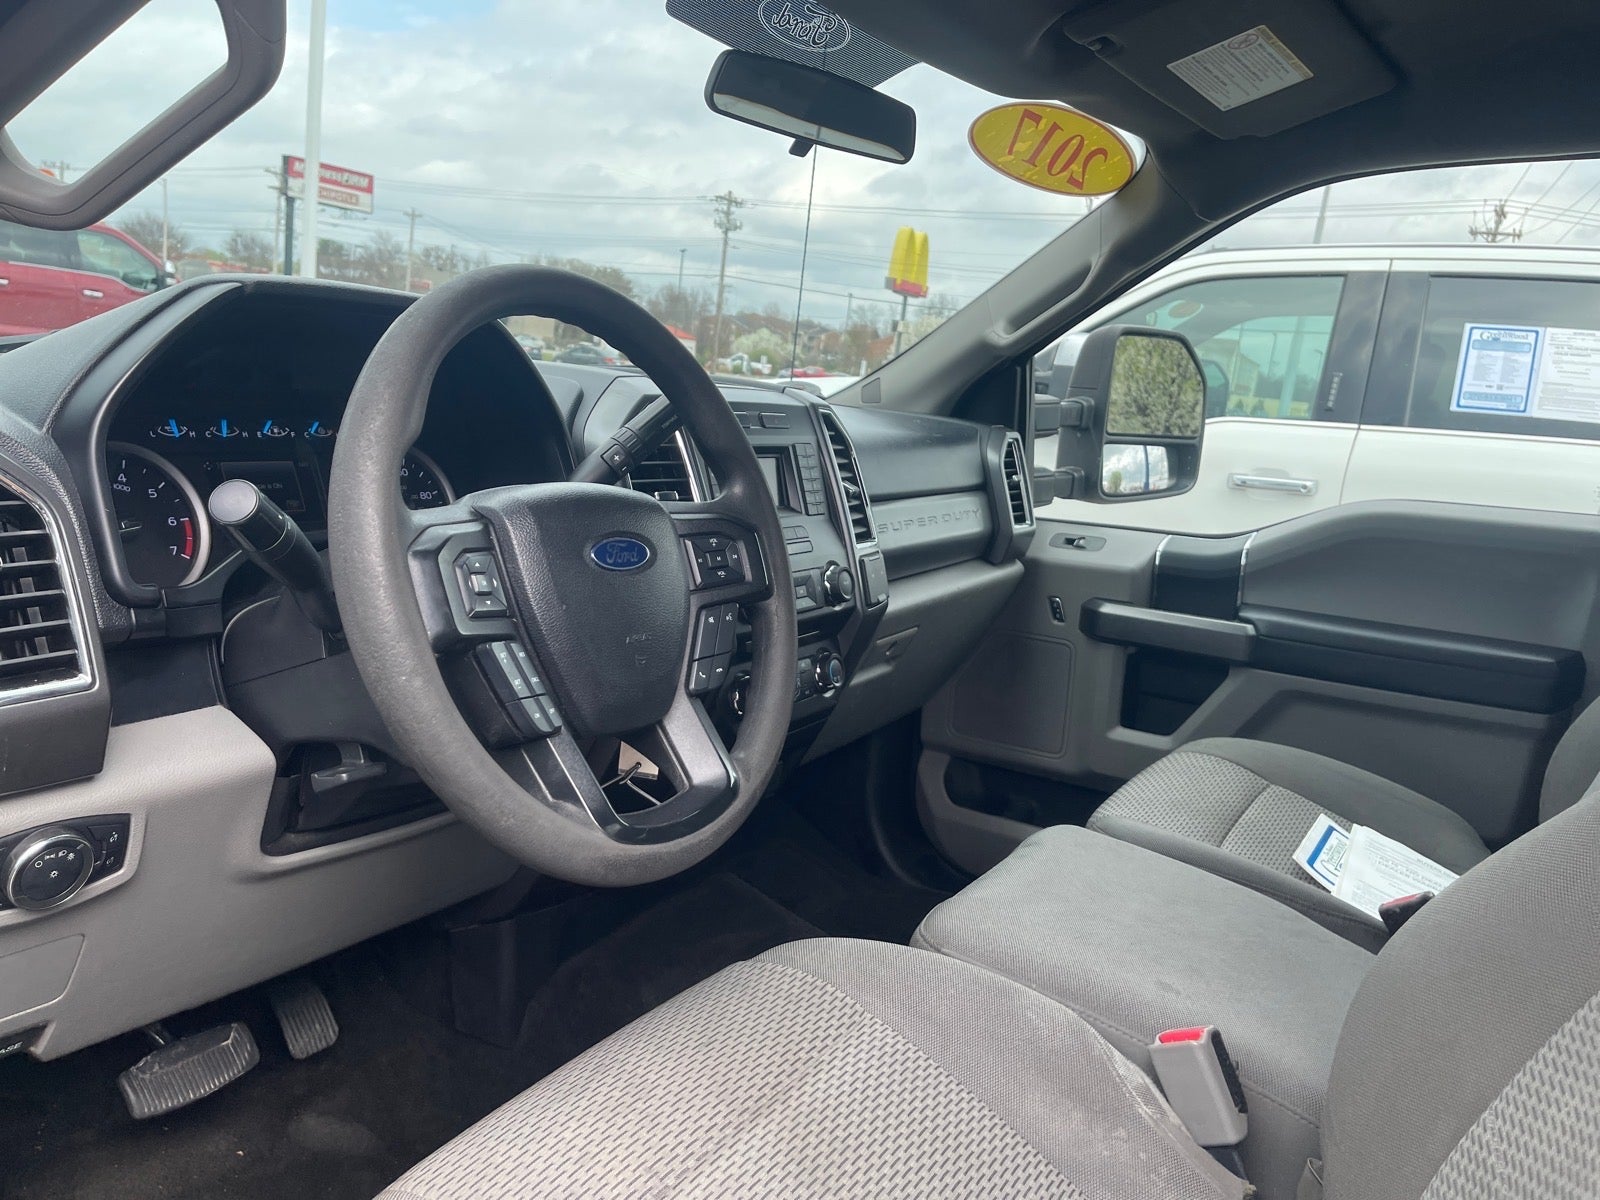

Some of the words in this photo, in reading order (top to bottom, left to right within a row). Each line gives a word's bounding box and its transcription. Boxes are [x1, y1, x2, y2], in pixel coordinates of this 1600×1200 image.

[118, 473, 127, 482] 4
[148, 488, 158, 498] 5
[420, 491, 432, 500] 80
[168, 517, 177, 526] 6
[877, 515, 938, 534] SUPER
[942, 508, 980, 523] DUTY
[169, 546, 178, 556] 7
[606, 542, 639, 564] Ford
